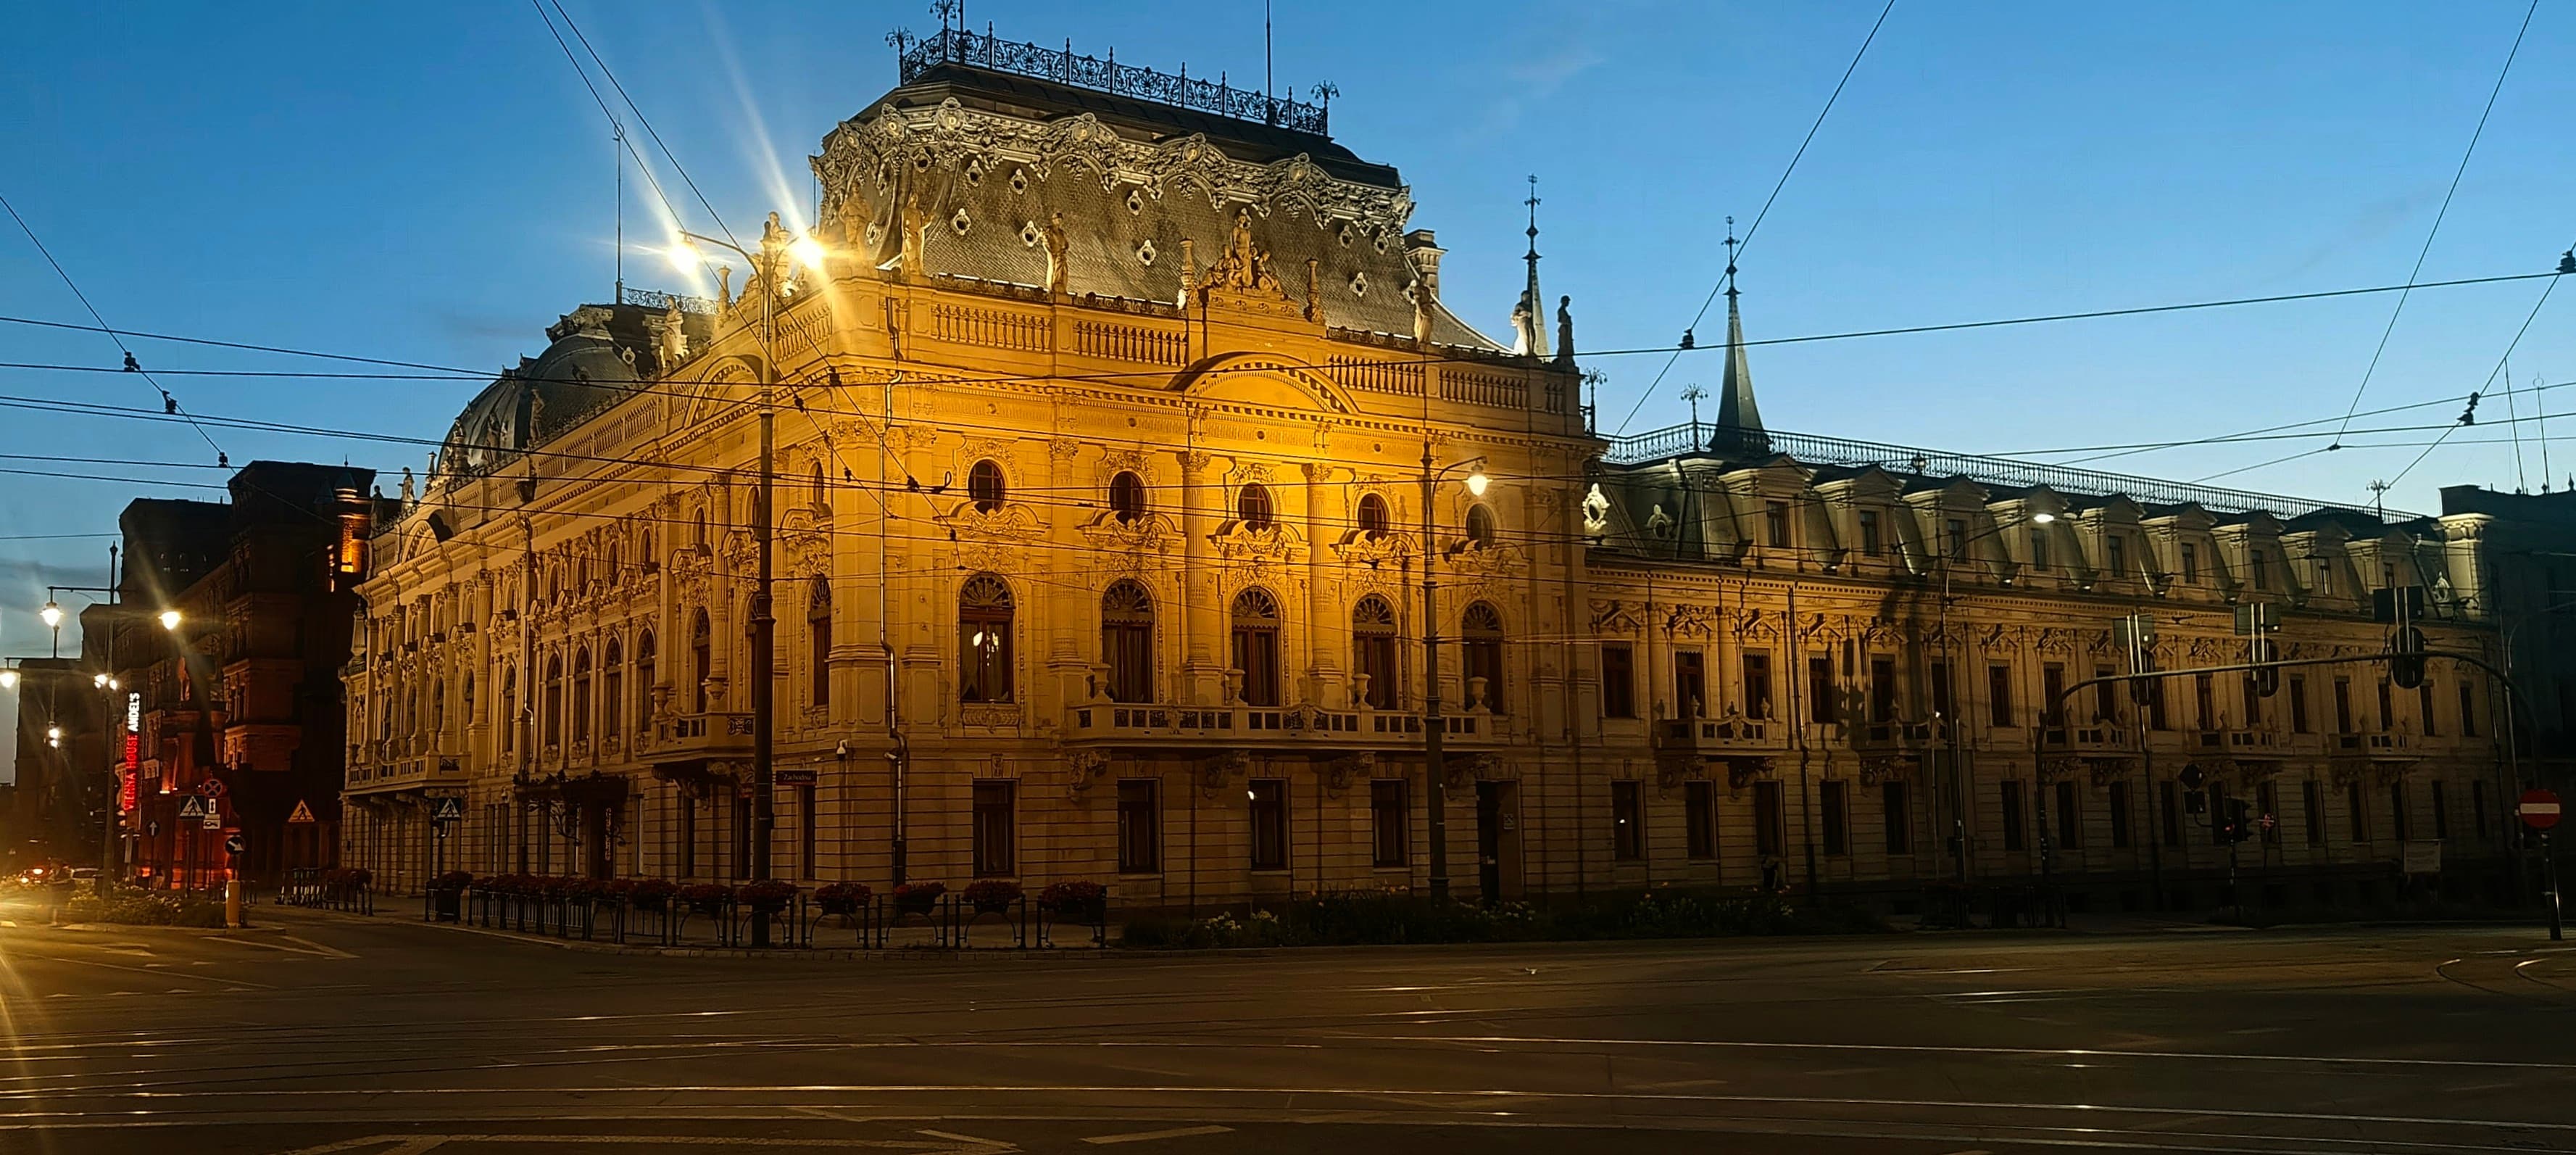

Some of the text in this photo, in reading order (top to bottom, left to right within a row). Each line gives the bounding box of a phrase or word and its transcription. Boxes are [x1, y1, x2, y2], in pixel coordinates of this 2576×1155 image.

[123, 692, 141, 811] VIENNA HOUSE ANDEL'S
